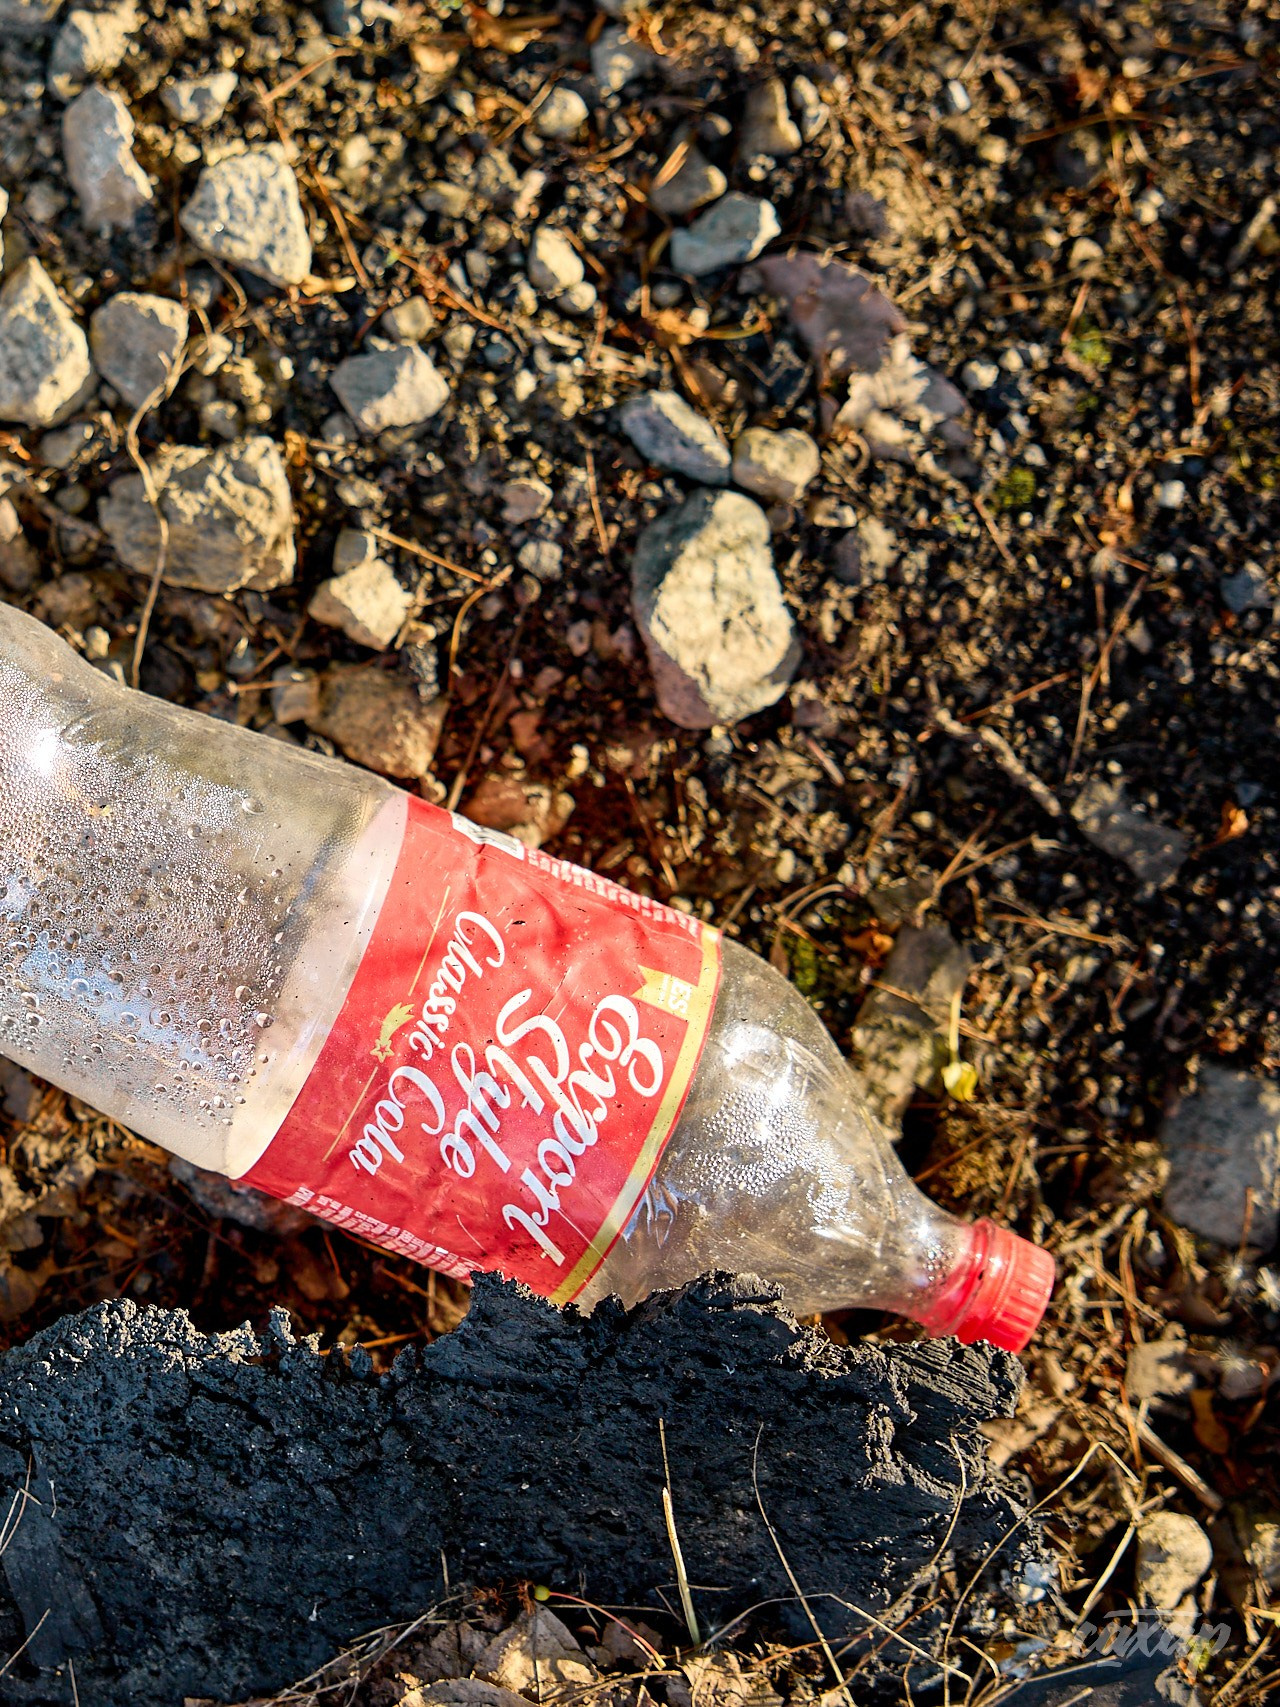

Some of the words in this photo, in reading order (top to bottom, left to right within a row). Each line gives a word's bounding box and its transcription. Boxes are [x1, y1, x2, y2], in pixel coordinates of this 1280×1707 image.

[408, 911, 506, 1061] Classic
[348, 1066, 447, 1176] Cola
[439, 988, 570, 1179] Style
[501, 994, 664, 1266] Export
